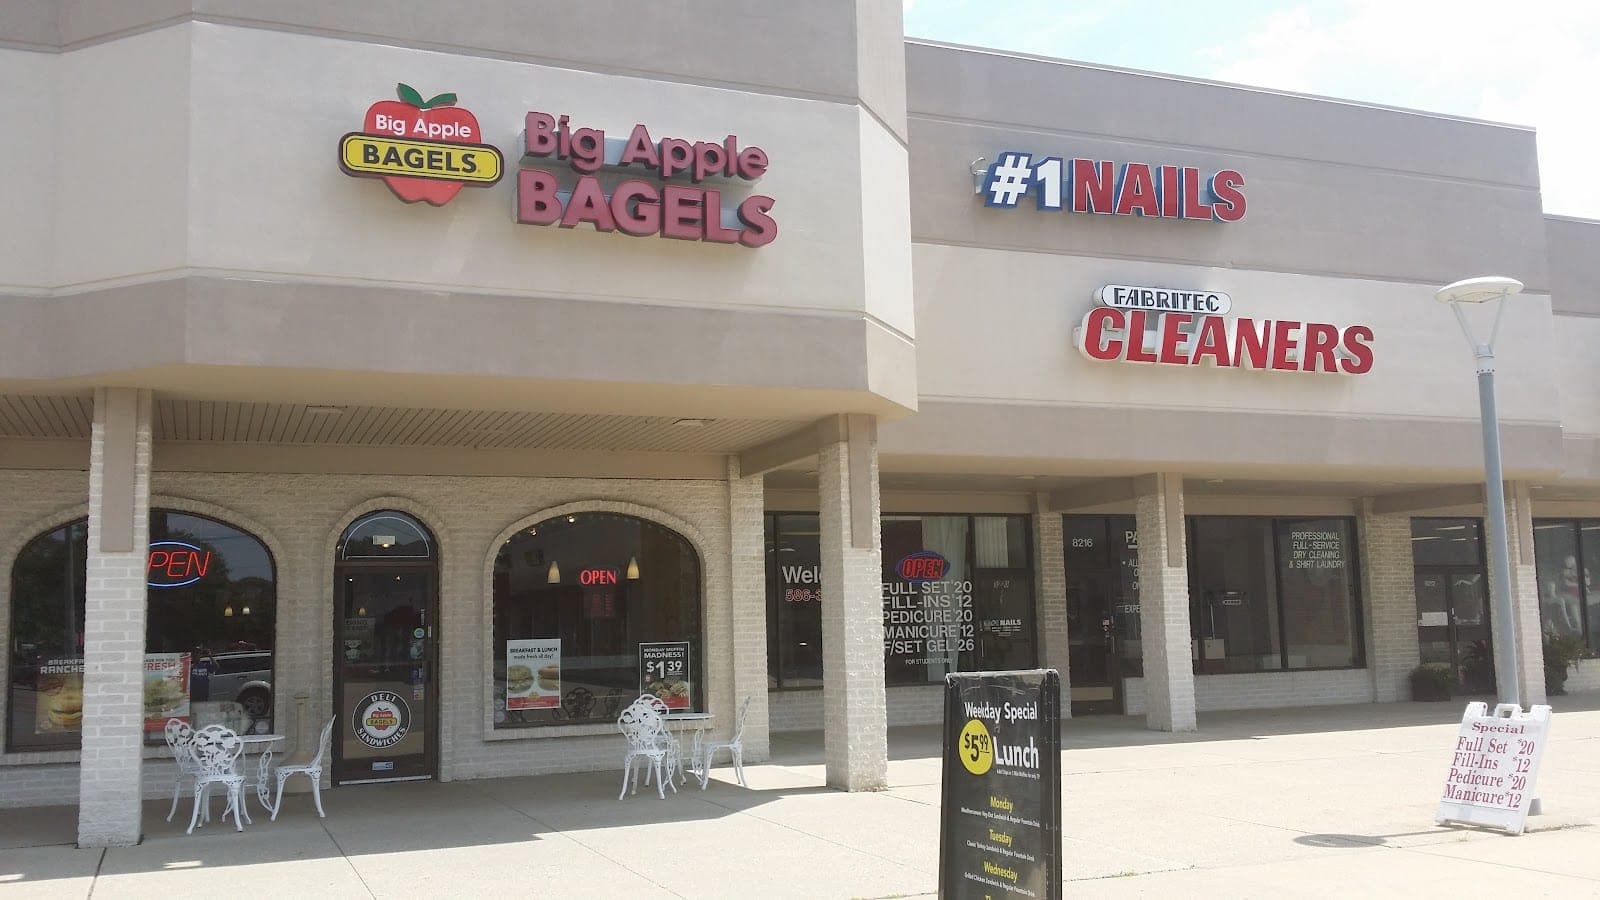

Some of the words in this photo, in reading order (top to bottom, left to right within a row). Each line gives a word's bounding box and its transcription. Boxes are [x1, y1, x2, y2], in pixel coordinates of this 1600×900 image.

[375, 114, 406, 135] Big
[413, 118, 472, 138] Apple
[523, 111, 605, 173] Big
[619, 123, 769, 184] Apple
[362, 143, 478, 173] BAGELS
[985, 152, 1063, 210] #1
[1072, 157, 1247, 222] NAILS
[517, 168, 778, 248] BAGELS
[1113, 287, 1220, 312] FABRITEC
[1083, 307, 1375, 375] CLEANERS
[1291, 531, 1340, 540] PROFESSIONAL
[1292, 541, 1340, 550] FULL-SERVICE
[1293, 550, 1307, 559] DRY
[1309, 550, 1340, 559] CLEANING
[902, 558, 944, 579] OPEN
[1288, 560, 1294, 569] &
[1296, 560, 1315, 569] SHIRT
[1317, 560, 1345, 569] LAUNDRY
[580, 569, 617, 585] OPEN
[782, 566, 821, 583] Wel
[881, 582, 918, 595] FULL
[921, 581, 950, 594] SET
[882, 595, 951, 609] FILL-INS
[883, 609, 952, 624] PEDICURE
[884, 624, 957, 639] MANICURE
[643, 651, 685, 659] MADNESS!
[926, 640, 955, 652] GEL
[370, 693, 397, 702] DELI
[964, 701, 1001, 724] Weekday
[1004, 701, 1038, 724] Special
[1471, 721, 1525, 734] Special
[357, 727, 406, 747] SANDWICHES
[1456, 736, 1483, 752] Full
[1488, 738, 1508, 754] Set
[993, 736, 1039, 769] Lunch
[1452, 751, 1499, 769] Fill-Ins
[1448, 767, 1503, 787] Pedicure
[1443, 783, 1504, 804] Manicure
[990, 796, 1013, 813] Monday
[989, 828, 1013, 847] Tuesday
[983, 861, 1018, 884] Wednesday
